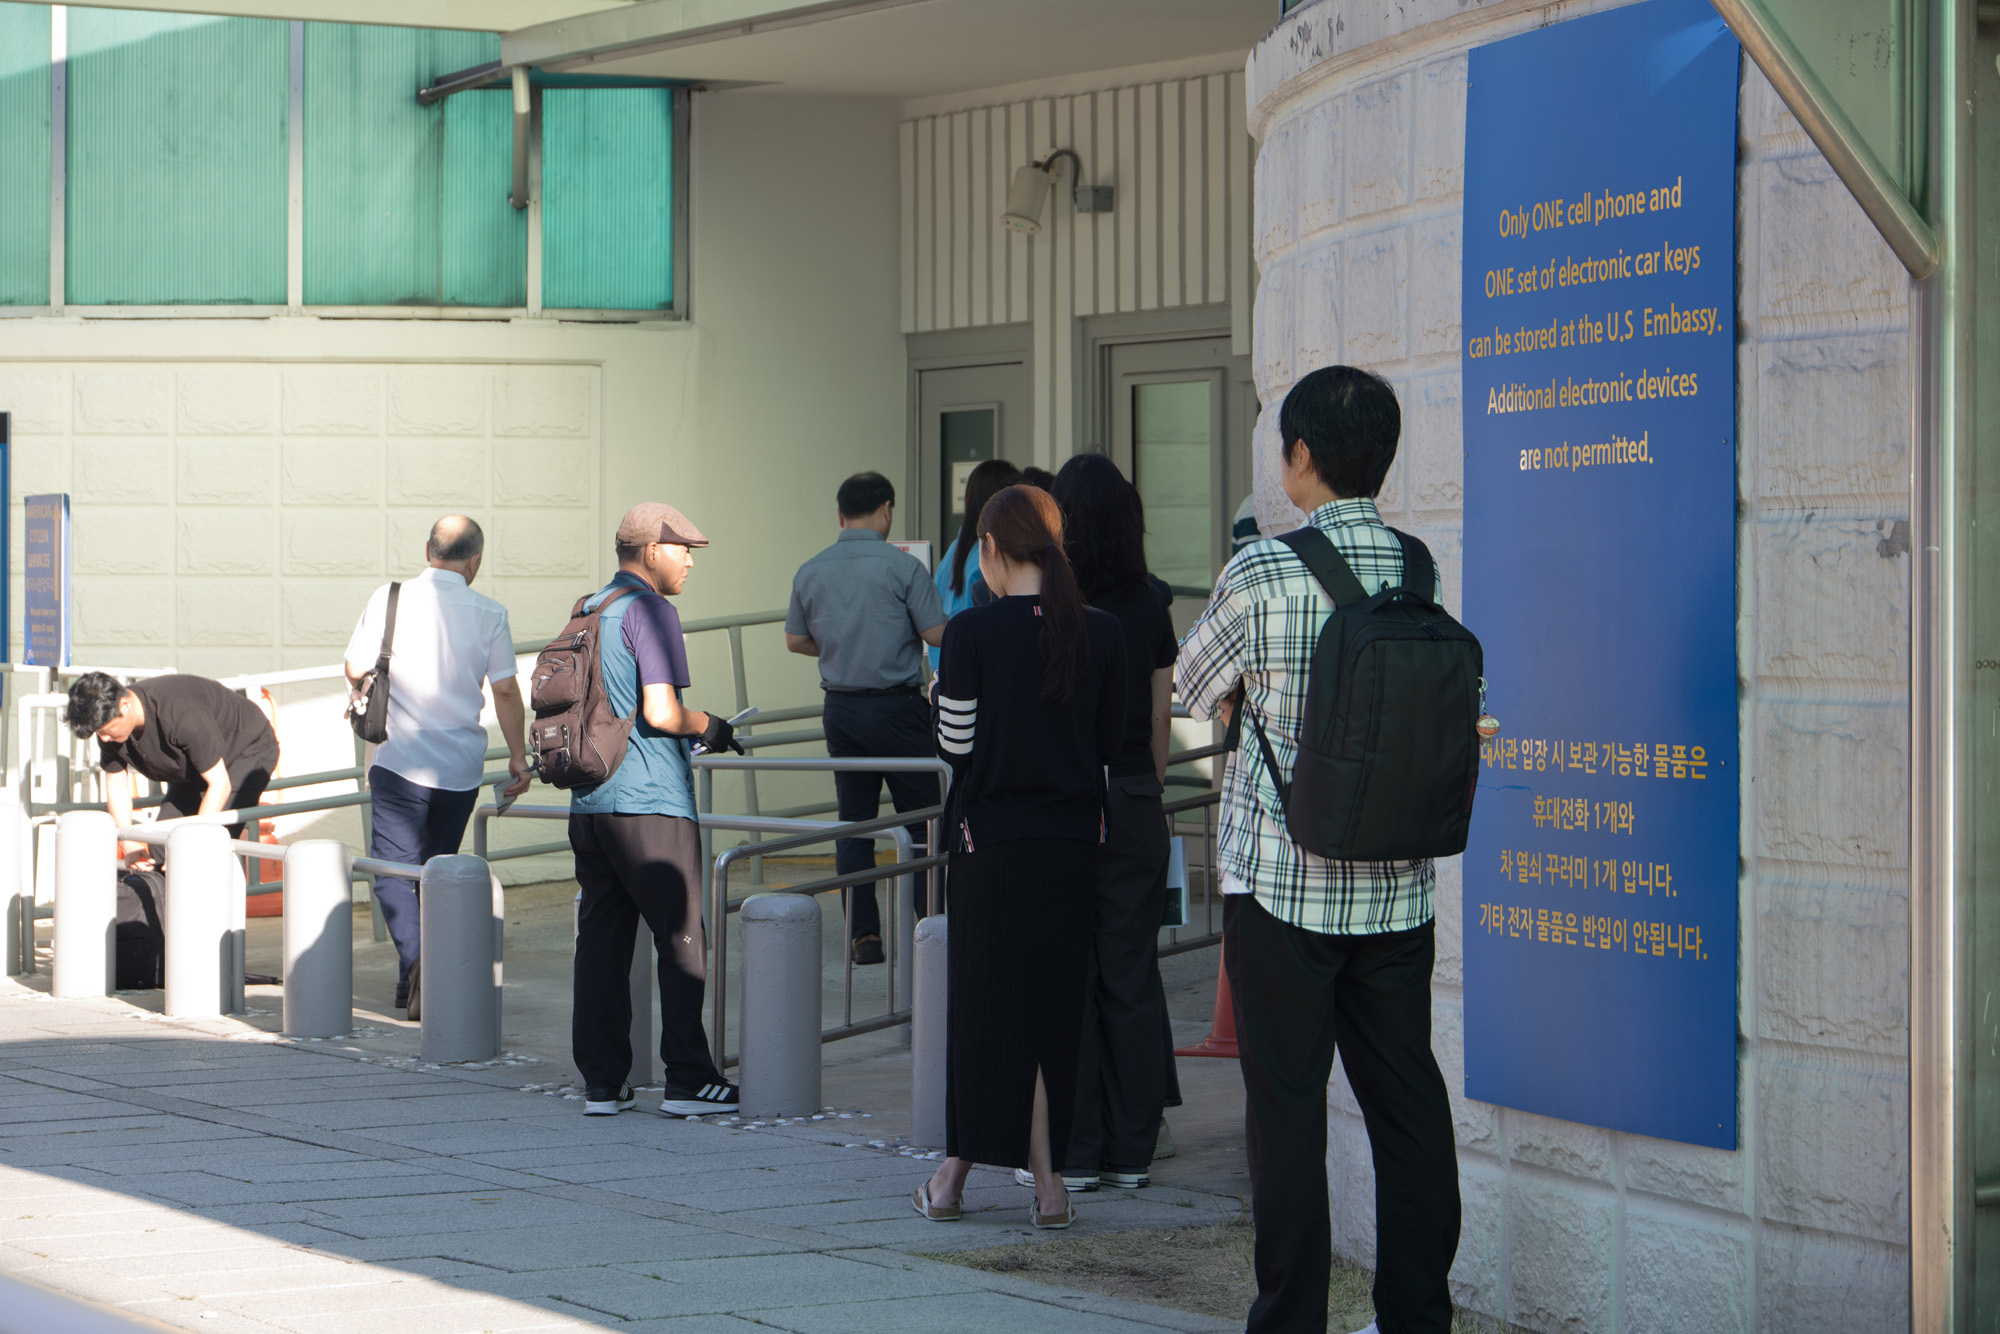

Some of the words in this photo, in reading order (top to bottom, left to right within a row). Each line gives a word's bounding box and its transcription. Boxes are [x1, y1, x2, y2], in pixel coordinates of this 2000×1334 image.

[1500, 205, 1529, 238] Only
[1533, 199, 1563, 231] ONE
[1568, 192, 1591, 225] cell
[1596, 189, 1645, 226] phone
[1650, 176, 1681, 211] and
[1486, 267, 1514, 298] ONE
[1518, 265, 1537, 293] set
[1541, 258, 1555, 289] of
[1559, 249, 1631, 287] electronic
[1636, 252, 1660, 275] car
[1665, 241, 1700, 275] keys
[1470, 336, 1491, 358] can
[1496, 327, 1511, 355] be
[1515, 318, 1557, 353] stored
[1561, 320, 1575, 346] at
[1579, 314, 1603, 344] the
[1644, 303, 1722, 336] Embassy.
[1488, 379, 1555, 414] Additional
[1560, 372, 1632, 407] electronic
[1637, 368, 1697, 399] devices
[1520, 448, 1541, 470] are
[1545, 441, 1569, 468] not
[1573, 431, 1653, 472] permitted.
[26, 504, 52, 518] AMERICAN
[30, 529, 48, 543] CITIZEN
[28, 553, 50, 568] SERVICES
[1522, 739, 1548, 771] 입장
[1552, 740, 1564, 772] 시
[1569, 741, 1598, 774] 보관
[1602, 742, 1649, 776] 가능한
[1653, 744, 1708, 779] 물품은
[1533, 796, 1589, 832] 휴대전화
[1595, 801, 1634, 835] 1개와
[1501, 850, 1513, 880] 차
[1517, 851, 1541, 884] 열쇠
[1546, 854, 1587, 889] 꾸러미
[1594, 859, 1616, 892] 1개
[1622, 861, 1677, 897] 입니다.
[1480, 903, 1505, 936] 기타
[1508, 906, 1533, 939] 전자
[1536, 909, 1578, 945] 물품은
[1583, 915, 1627, 952] 반입이
[1633, 921, 1707, 960] 안됩니다.
